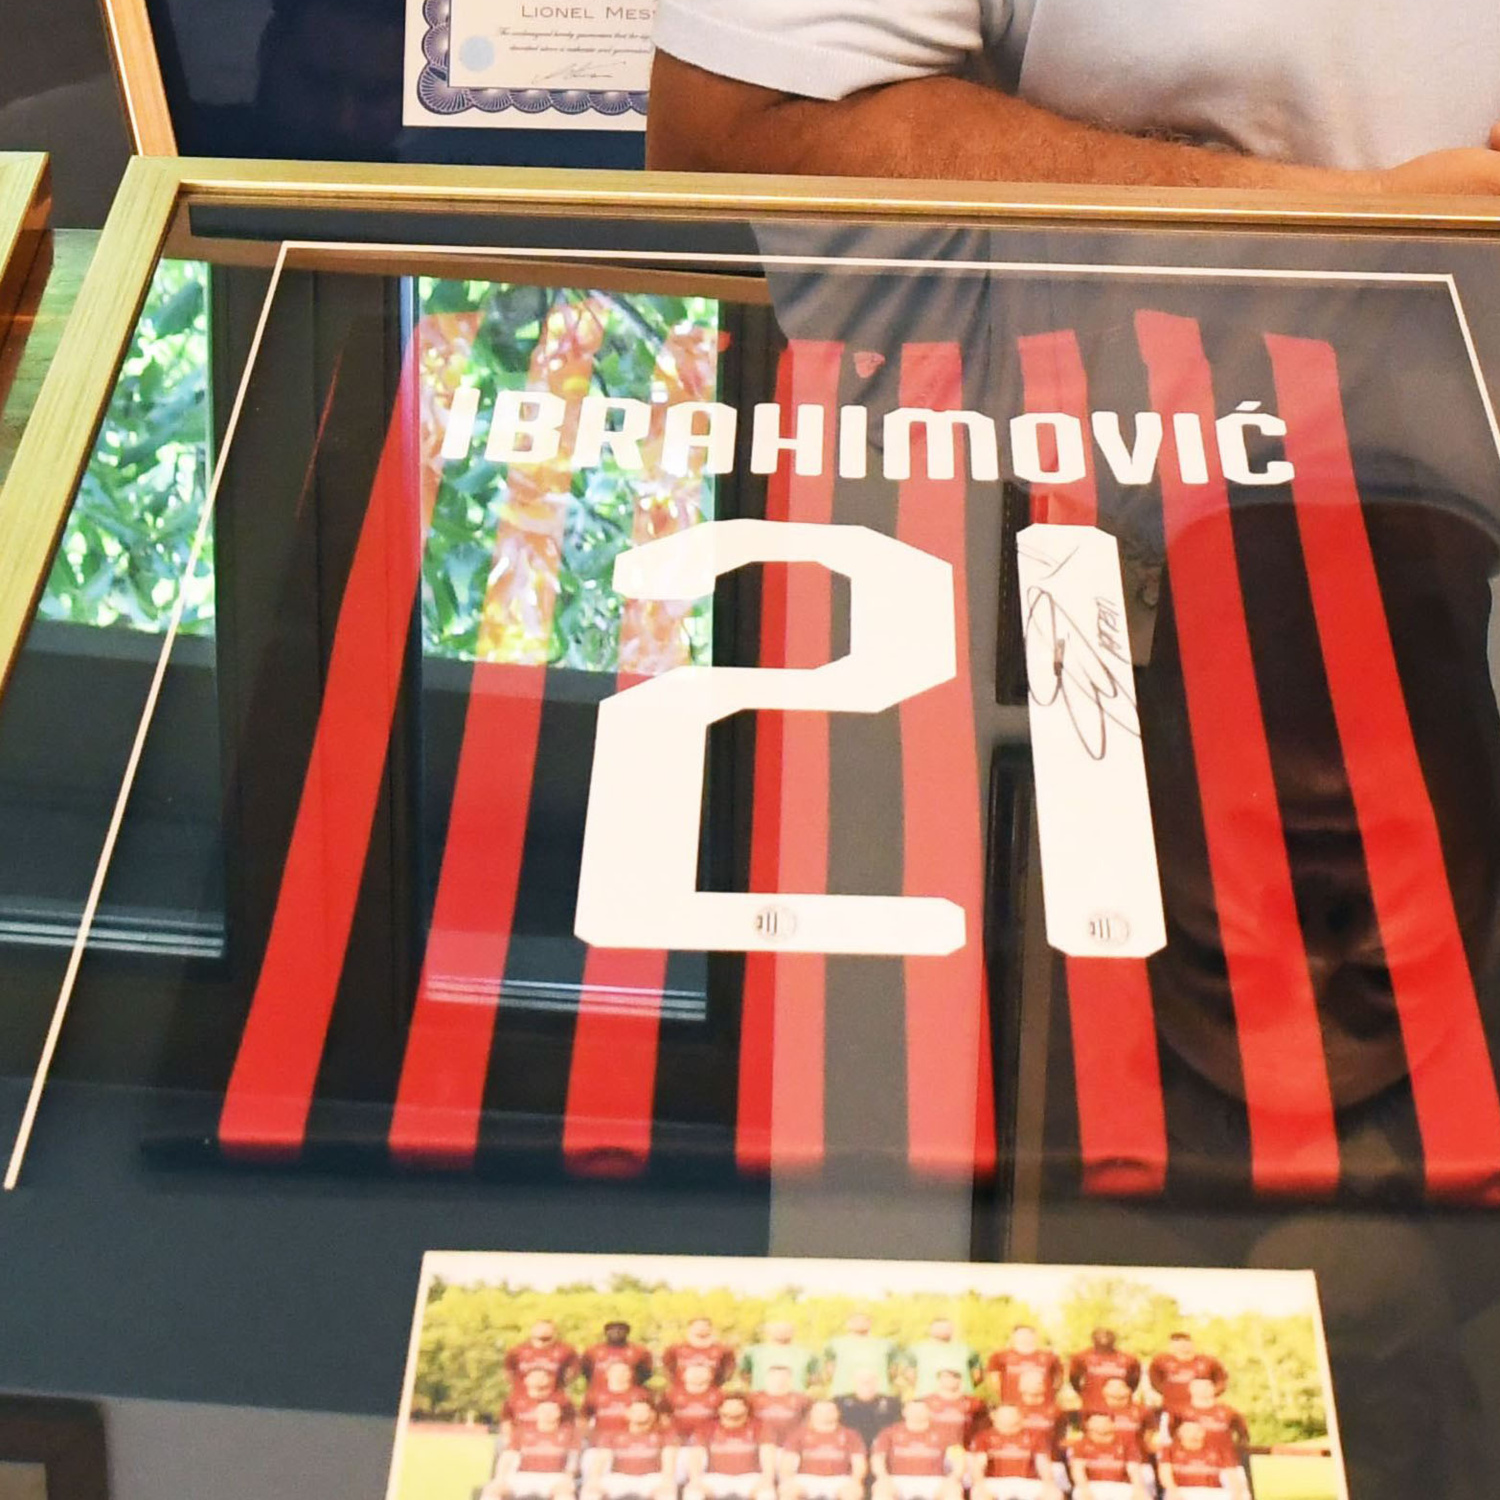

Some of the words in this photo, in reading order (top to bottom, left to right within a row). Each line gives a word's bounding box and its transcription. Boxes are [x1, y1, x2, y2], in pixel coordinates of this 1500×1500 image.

[521, 5, 595, 19] LIONEL
[606, 6, 656, 20] MES
[441, 388, 1295, 485] IBRAHIMOVIĆ
[574, 518, 1167, 957] 21
